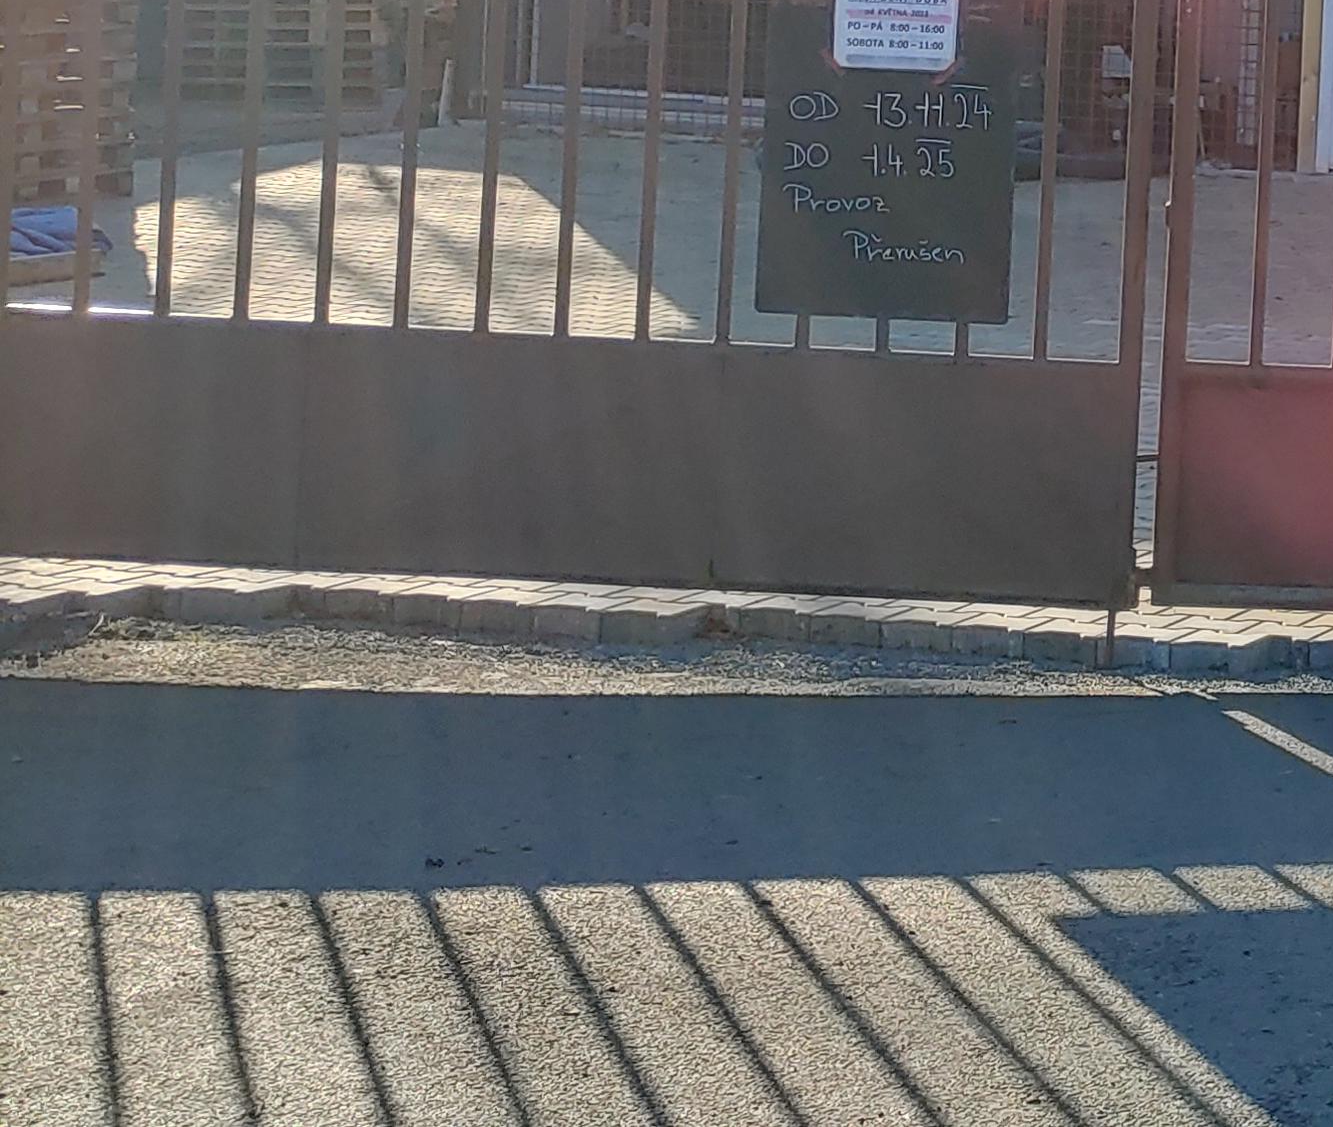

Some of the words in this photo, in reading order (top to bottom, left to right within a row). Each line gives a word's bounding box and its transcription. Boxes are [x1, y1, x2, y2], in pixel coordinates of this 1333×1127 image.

[846, 37, 884, 47] SOBOTA
[789, 91, 840, 121] OD
[783, 142, 830, 171] DO
[782, 183, 891, 213] Provoz
